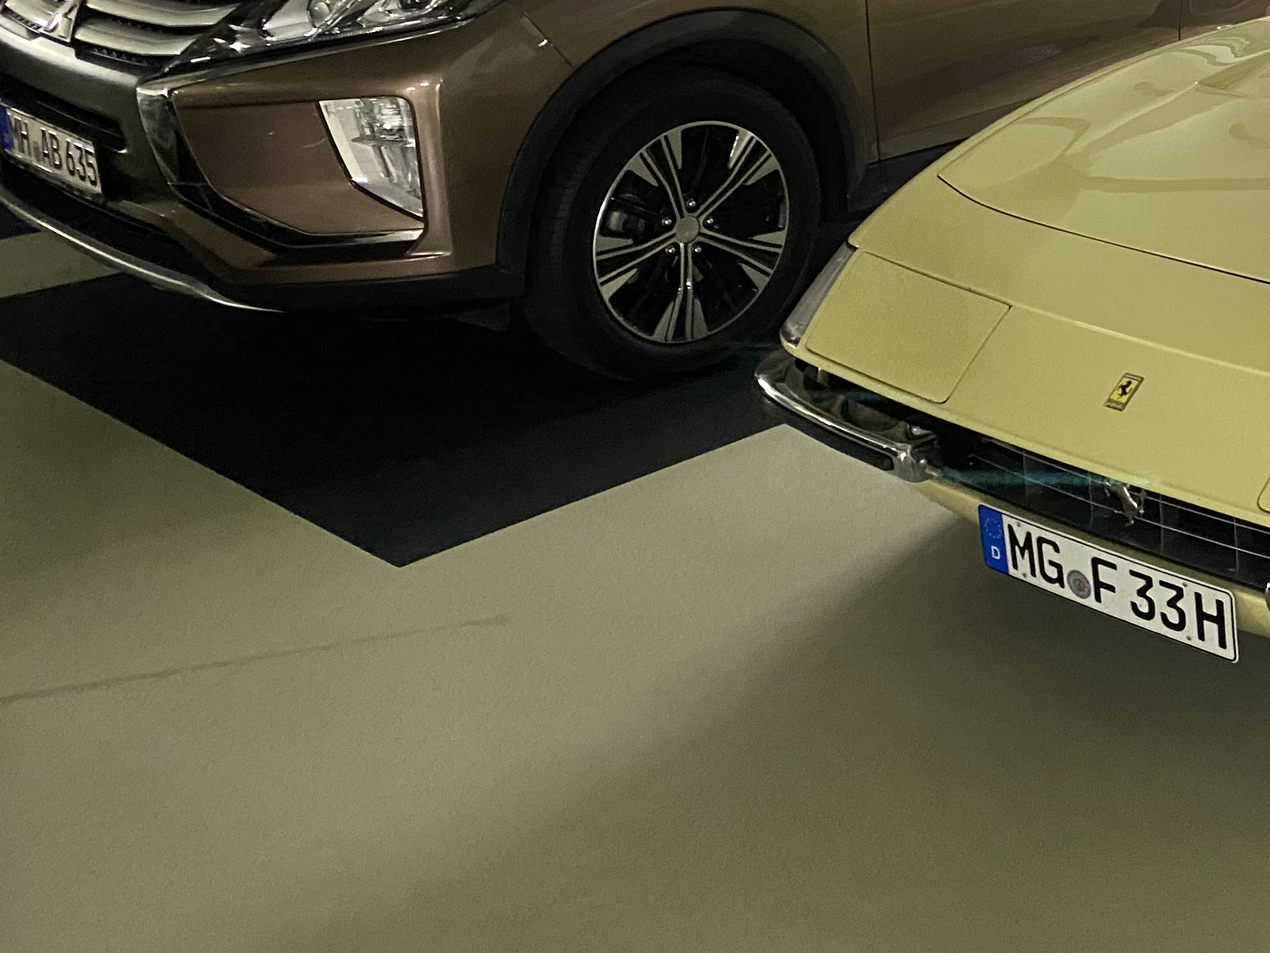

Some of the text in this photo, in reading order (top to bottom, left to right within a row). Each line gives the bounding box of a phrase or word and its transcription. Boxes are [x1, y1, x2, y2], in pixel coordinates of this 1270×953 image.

[40, 127, 62, 170] AB
[65, 138, 97, 187] 635
[1007, 523, 1065, 589] MG
[1090, 556, 1118, 604] F
[1129, 568, 1229, 650] 33H
